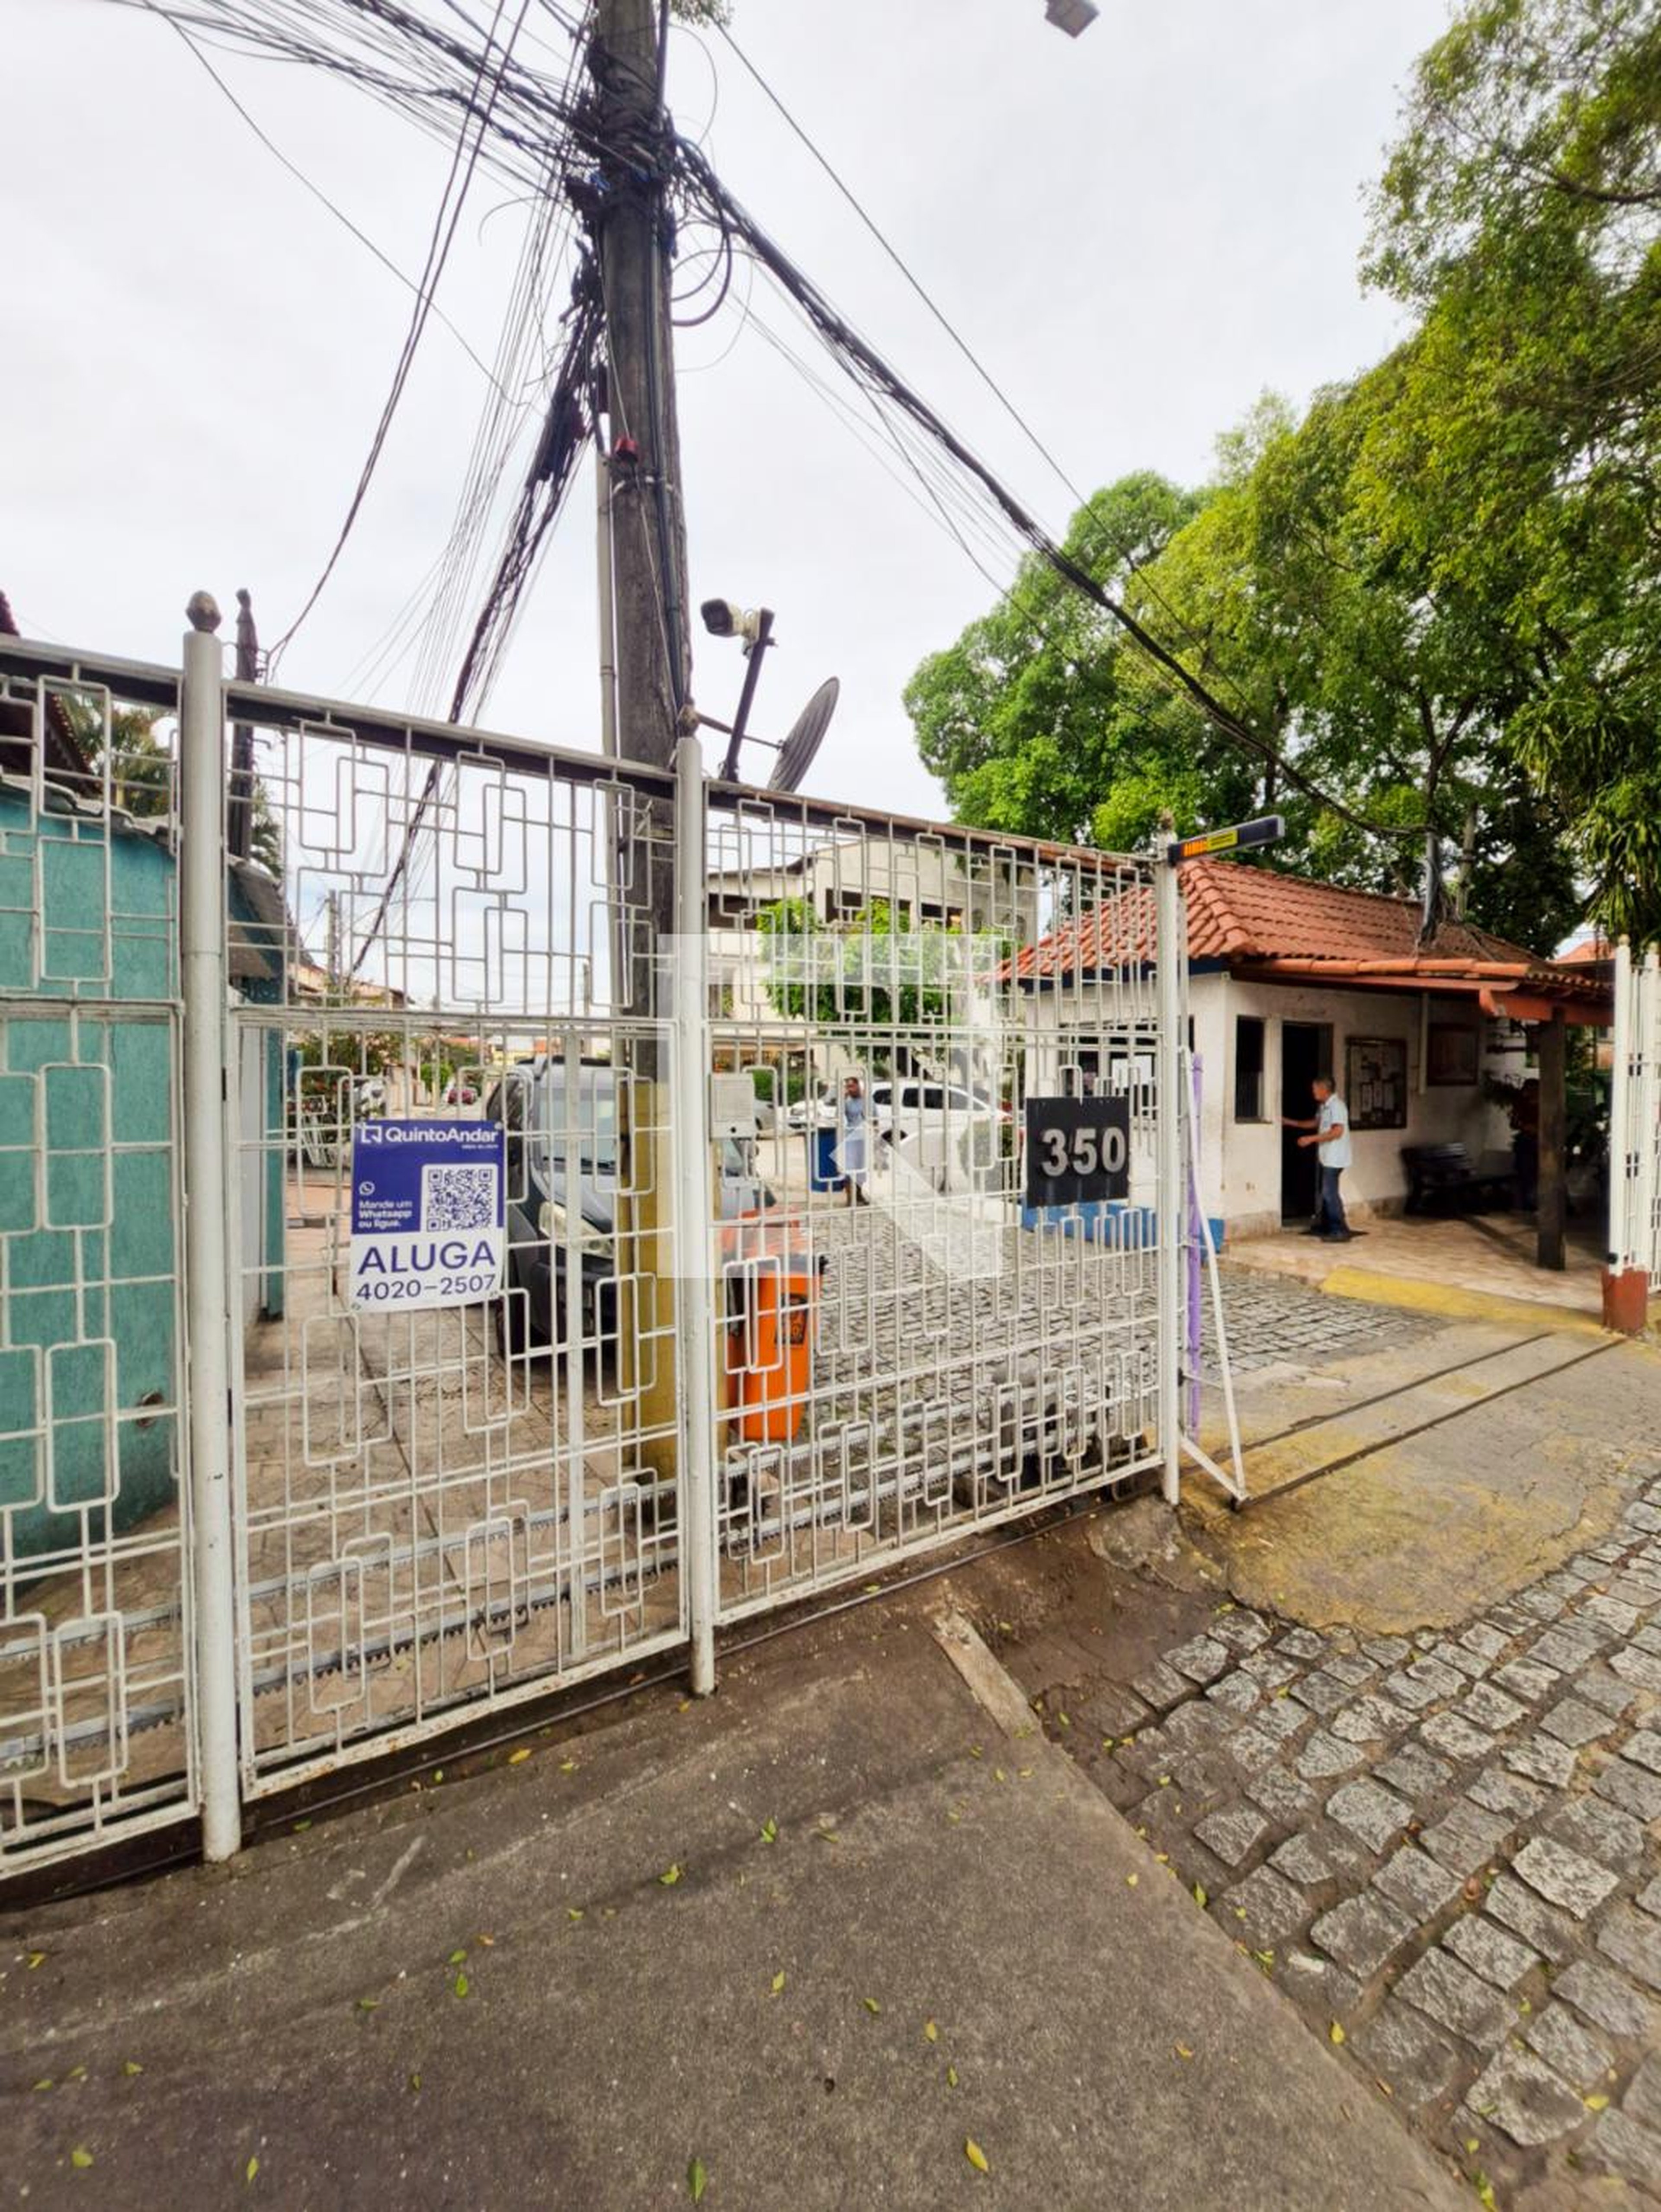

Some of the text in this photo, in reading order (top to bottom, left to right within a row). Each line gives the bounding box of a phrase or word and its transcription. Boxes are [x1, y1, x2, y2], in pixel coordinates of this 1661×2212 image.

[385, 1127, 498, 1143] QuintoAndar
[1042, 1127, 1125, 1177] 350
[358, 1240, 496, 1275] ALUGA
[356, 1274, 496, 1301] 4020-2507
